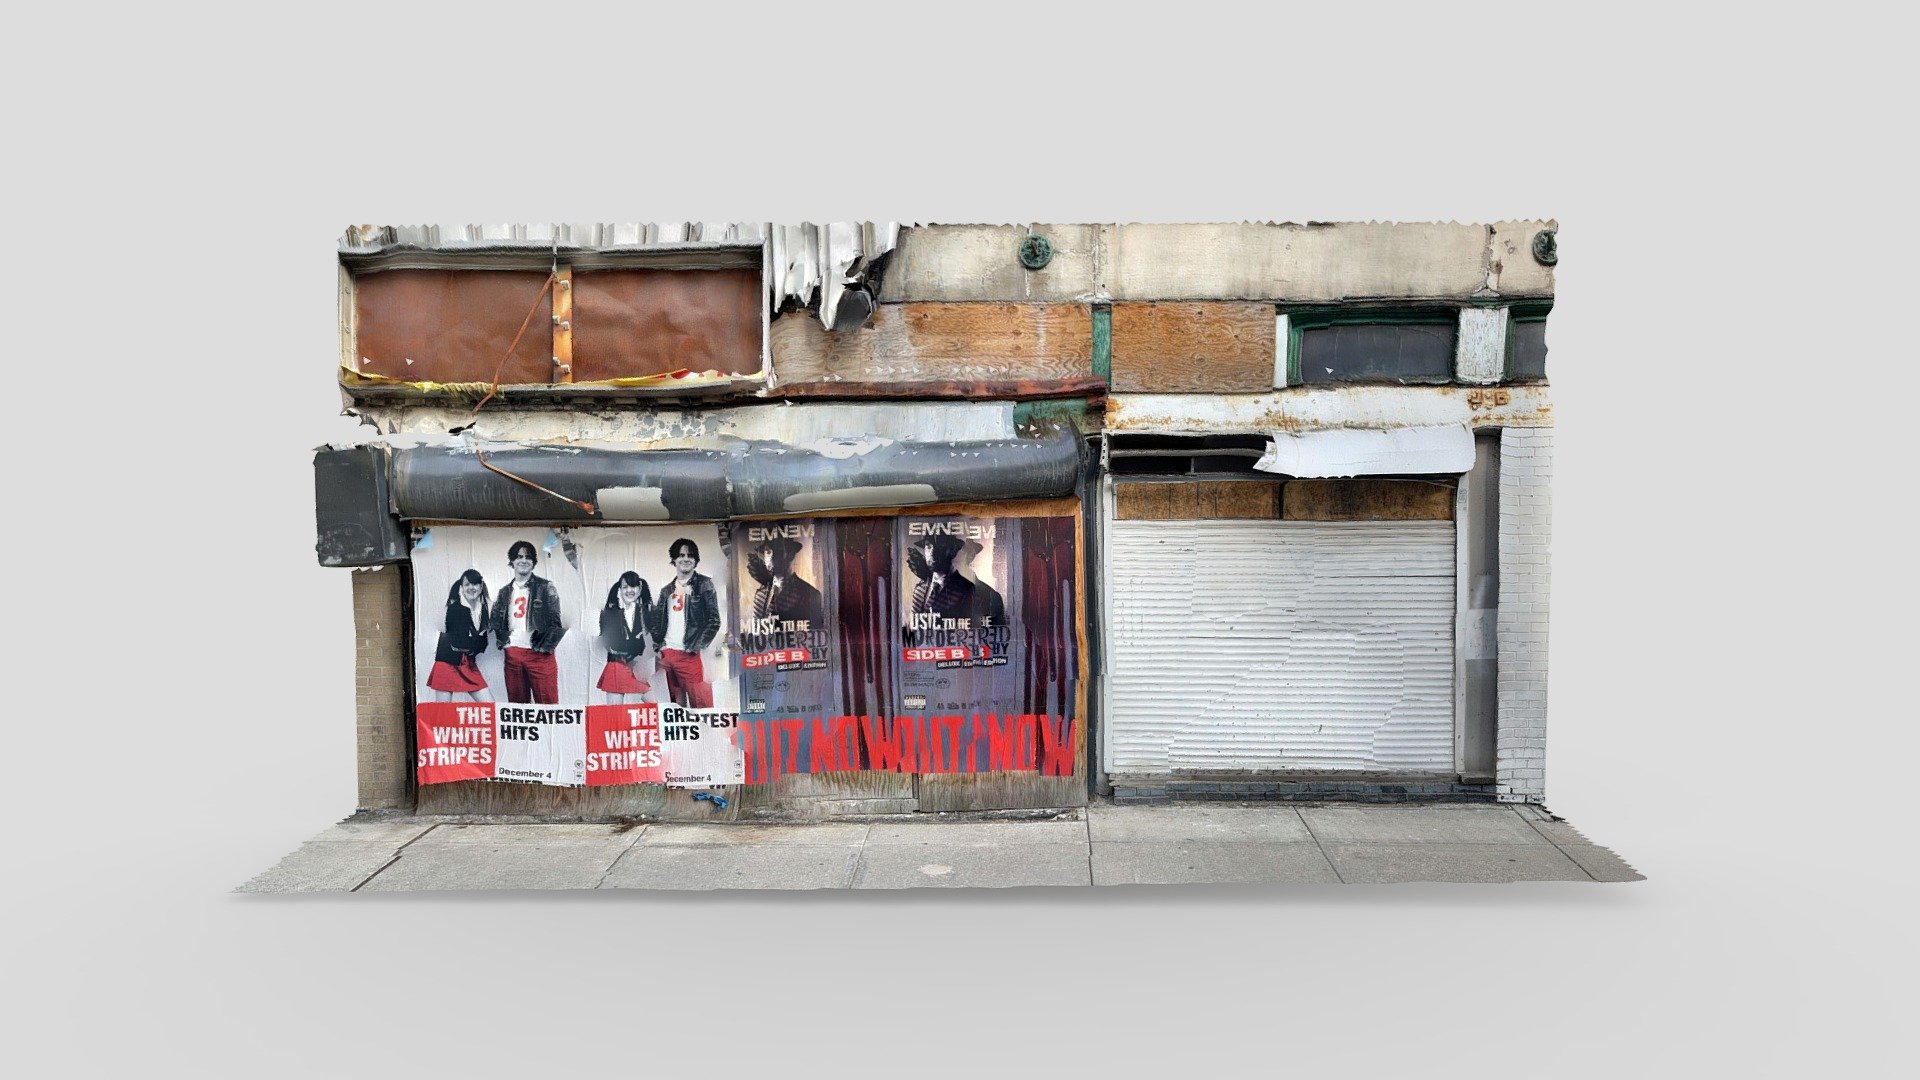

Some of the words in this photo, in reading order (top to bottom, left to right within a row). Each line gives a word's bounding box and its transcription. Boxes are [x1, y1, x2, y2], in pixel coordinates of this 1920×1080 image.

[513, 597, 527, 619] 3
[672, 593, 684, 612] 3
[791, 651, 805, 661] B
[906, 650, 947, 660] SIDE
[951, 649, 965, 659] B
[456, 707, 492, 724] THE
[500, 707, 583, 724] GREATEST
[628, 708, 658, 727] THE
[433, 726, 493, 745] WHITE
[500, 726, 540, 741] HITS
[664, 725, 700, 741] HITS
[418, 747, 493, 767] STRIPES
[587, 750, 662, 771] STRIPES
[499, 767, 544, 778] December
